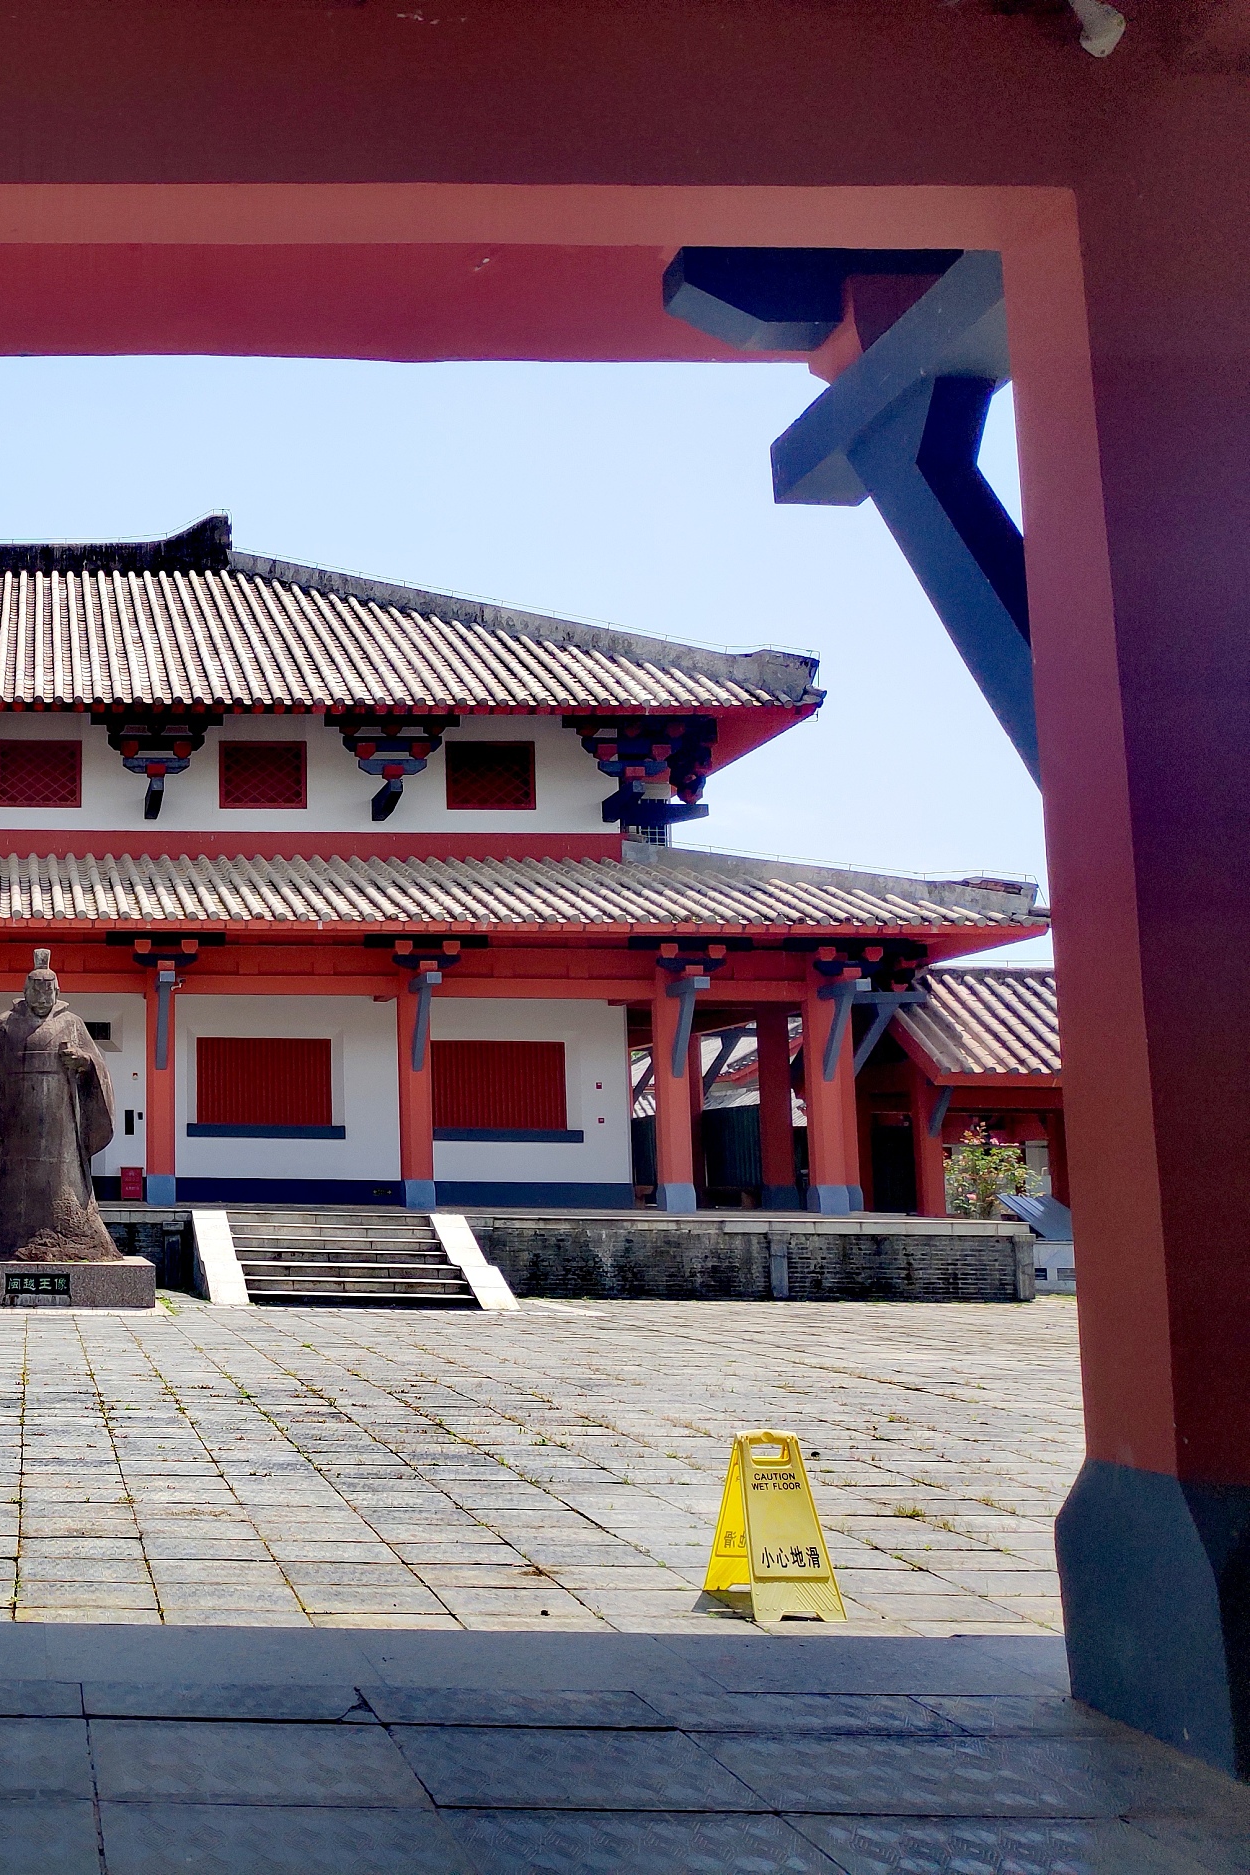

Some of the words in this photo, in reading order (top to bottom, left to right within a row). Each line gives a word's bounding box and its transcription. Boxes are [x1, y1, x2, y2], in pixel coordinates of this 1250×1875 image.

[753, 1472, 796, 1481] CAUTION
[751, 1482, 769, 1490] WET
[772, 1482, 801, 1490] FLOOR
[761, 1545, 821, 1569] 小心地滑
